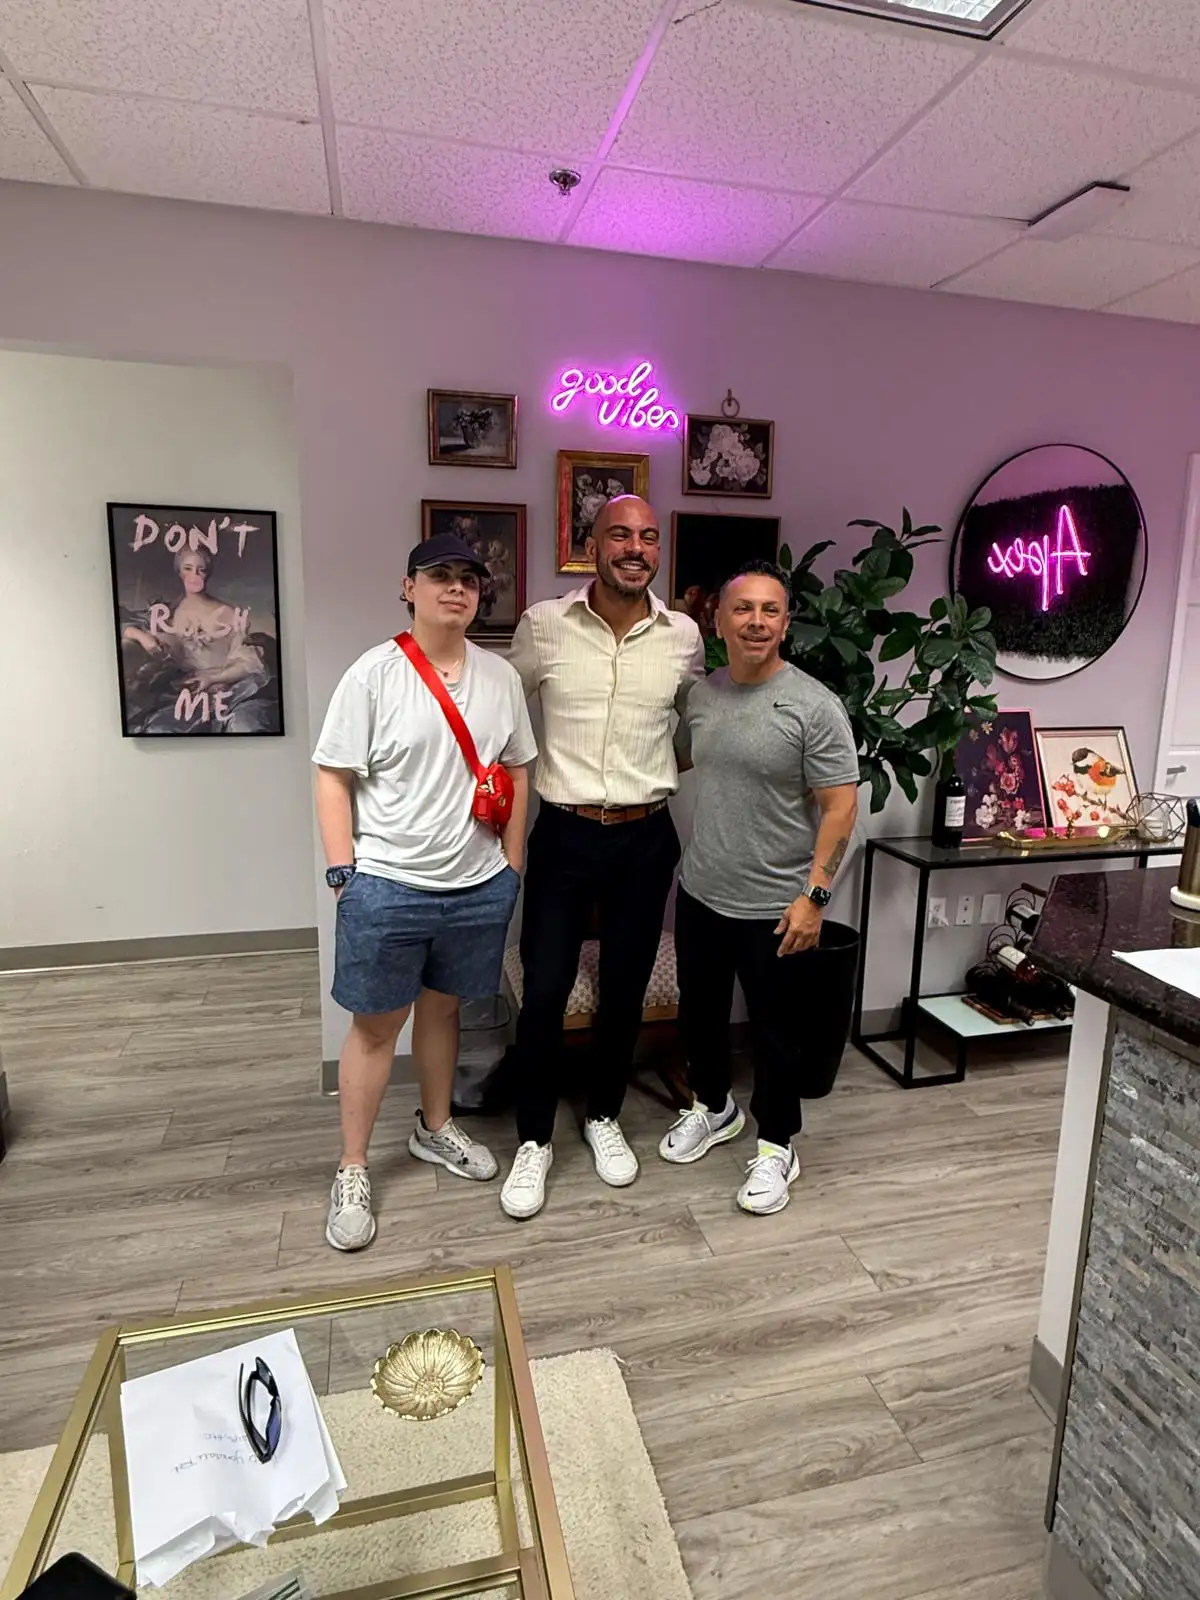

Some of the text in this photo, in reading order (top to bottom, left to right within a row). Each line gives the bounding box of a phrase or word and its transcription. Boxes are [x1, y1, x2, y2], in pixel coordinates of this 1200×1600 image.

[552, 361, 652, 411] good
[599, 388, 679, 429] vibes
[132, 514, 260, 558] DON'T
[150, 603, 250, 637] RSH
[174, 688, 235, 722] ME
